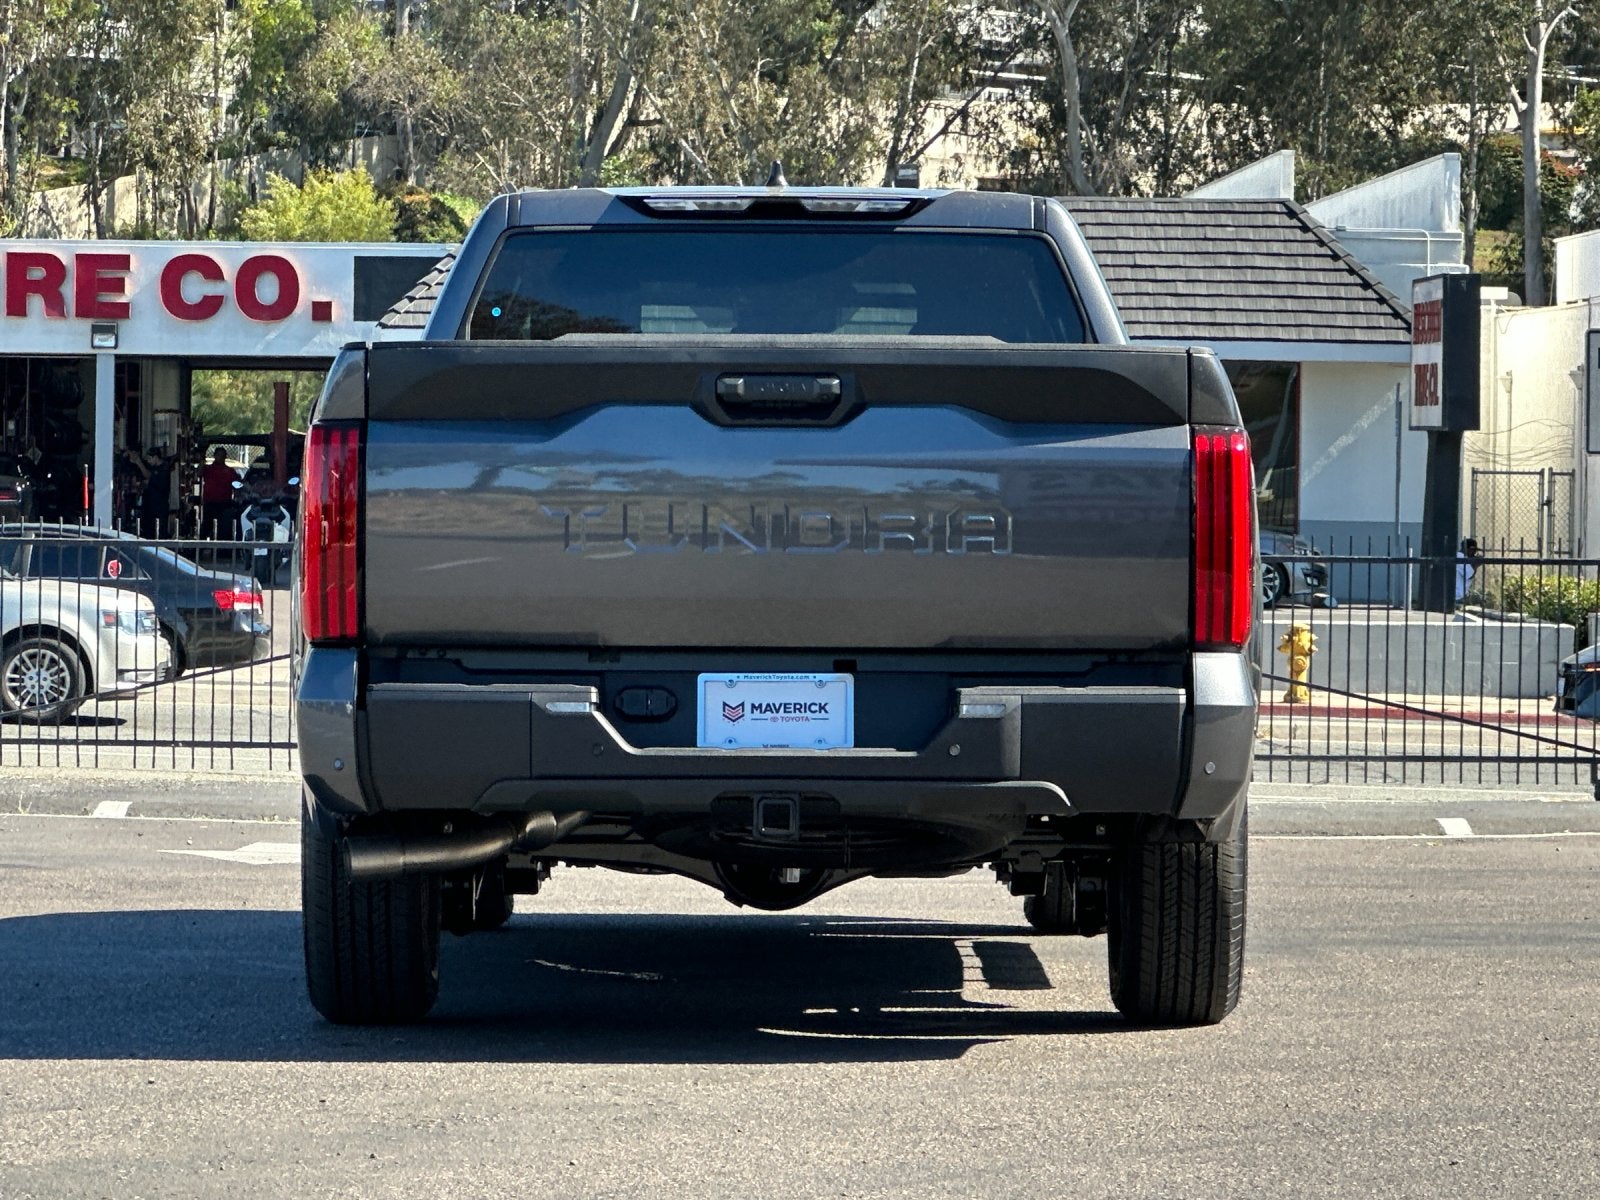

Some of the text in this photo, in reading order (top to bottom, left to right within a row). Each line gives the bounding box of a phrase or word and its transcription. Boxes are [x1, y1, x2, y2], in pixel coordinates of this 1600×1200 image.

[5, 252, 333, 322] RE CO.
[540, 502, 1013, 555] TUNDRA
[750, 702, 829, 714] MAVERICK
